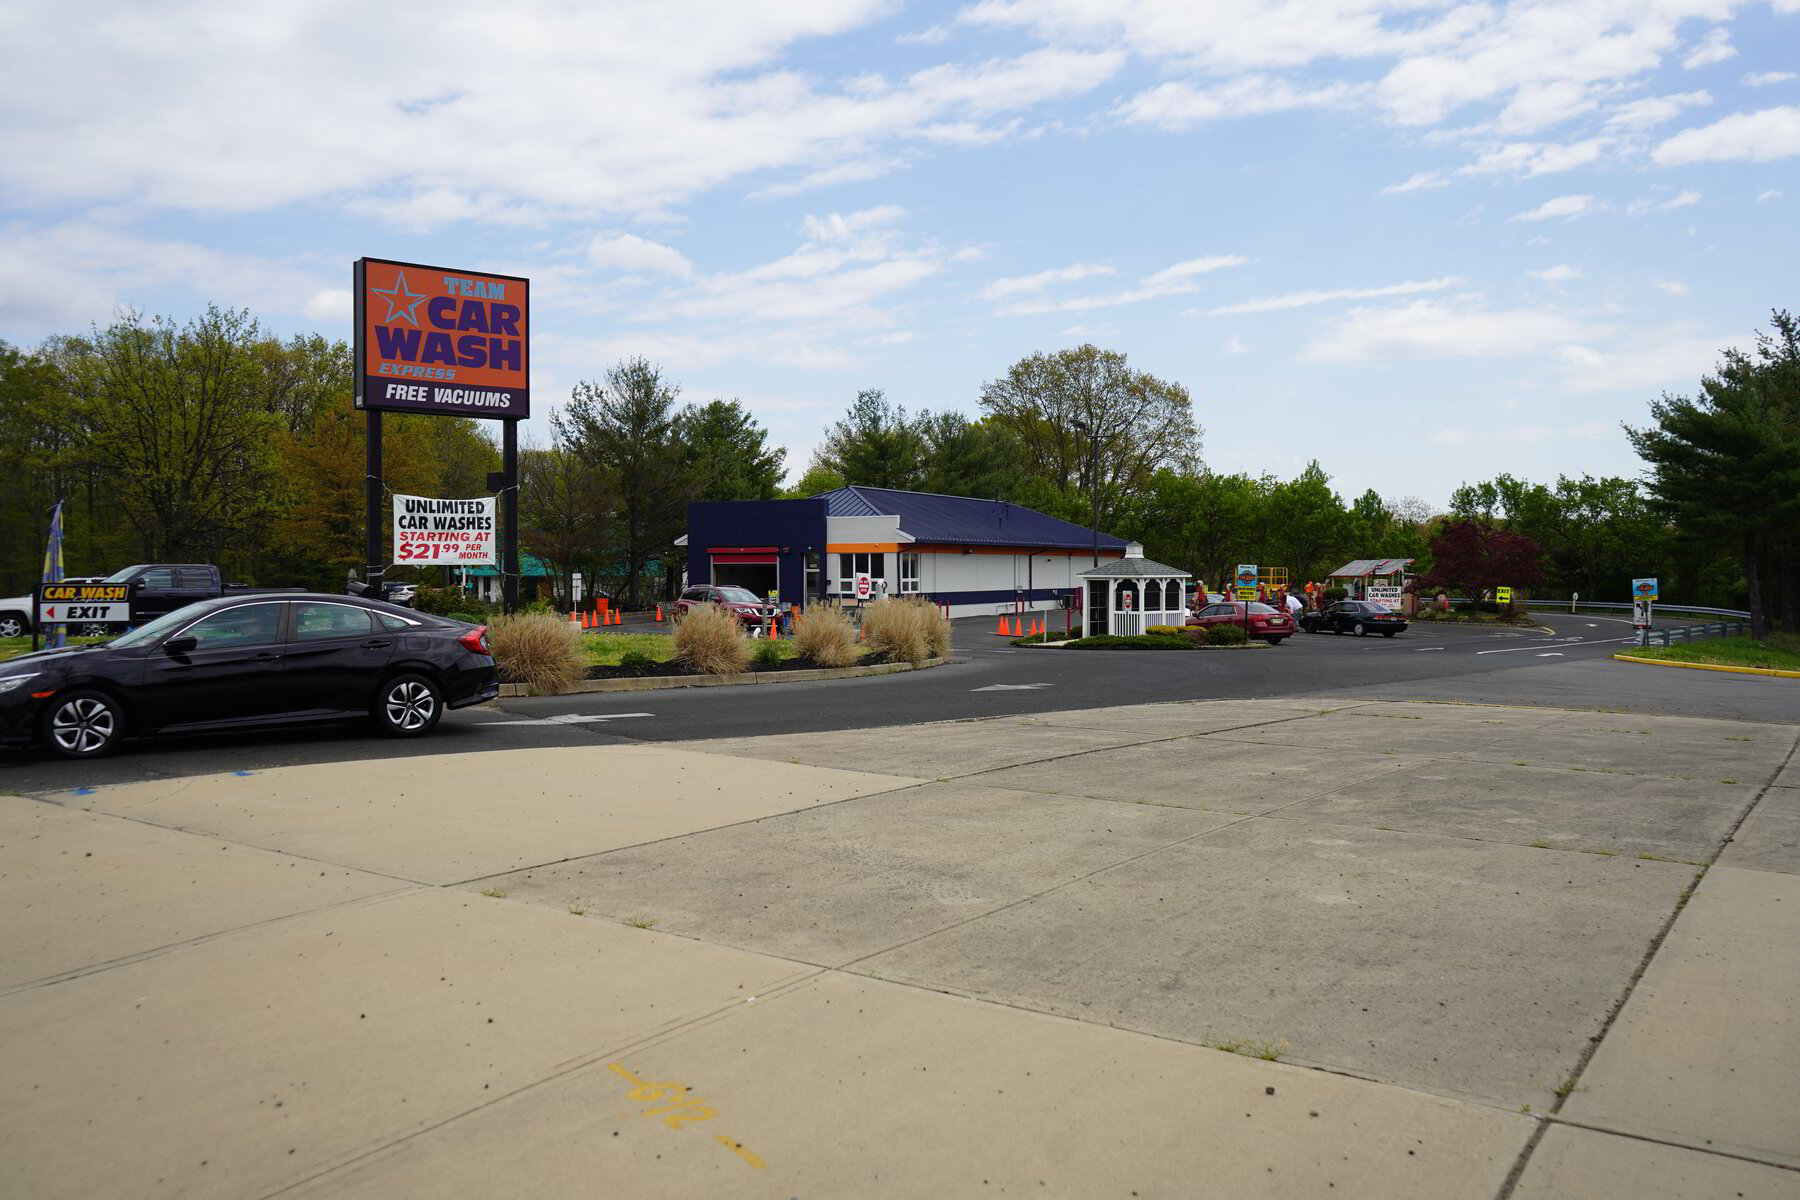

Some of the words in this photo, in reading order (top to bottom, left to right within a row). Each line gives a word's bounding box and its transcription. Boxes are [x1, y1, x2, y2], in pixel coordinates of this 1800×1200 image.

[444, 276, 505, 300] TEAM
[427, 295, 521, 337] CAR
[374, 324, 521, 372] WASH
[378, 363, 457, 380] EXPRESS
[385, 383, 429, 402] FREE
[434, 387, 511, 408] VACUUMS
[405, 499, 485, 514] UNLIMITED
[398, 515, 428, 530] CAR
[433, 516, 492, 531] WASHES
[399, 531, 470, 542] STARTING
[474, 532, 491, 542] AT
[465, 543, 482, 551] PER
[458, 551, 488, 559] MONTH
[44, 587, 76, 598] CAR
[80, 587, 125, 598] WASH
[67, 606, 110, 618] EXIT
